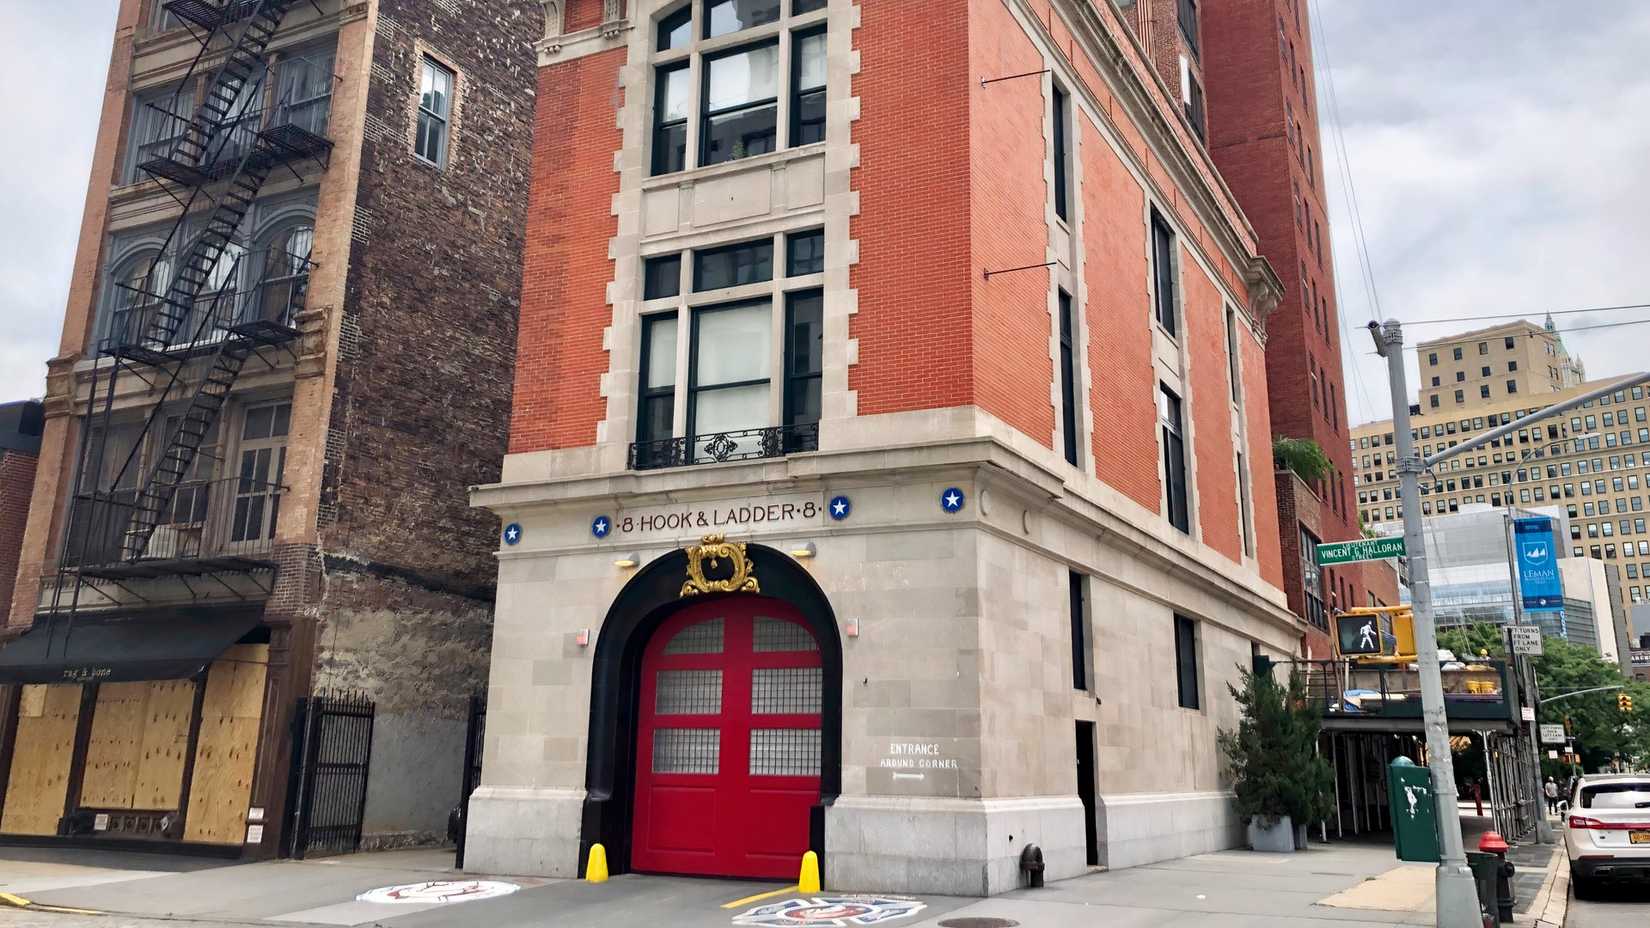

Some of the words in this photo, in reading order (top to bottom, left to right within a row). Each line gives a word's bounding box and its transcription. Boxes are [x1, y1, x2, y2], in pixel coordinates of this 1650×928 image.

[622, 517, 634, 533] 8
[640, 512, 692, 532] HOOK
[696, 511, 709, 527] &
[713, 503, 795, 526] LADDER
[802, 501, 816, 519] 8
[1321, 548, 1351, 559] VINCENT
[1363, 543, 1403, 555] HALLORAN
[890, 743, 940, 756] ENTRANCE
[880, 758, 915, 769] AROUND
[918, 758, 958, 769] CORNER
